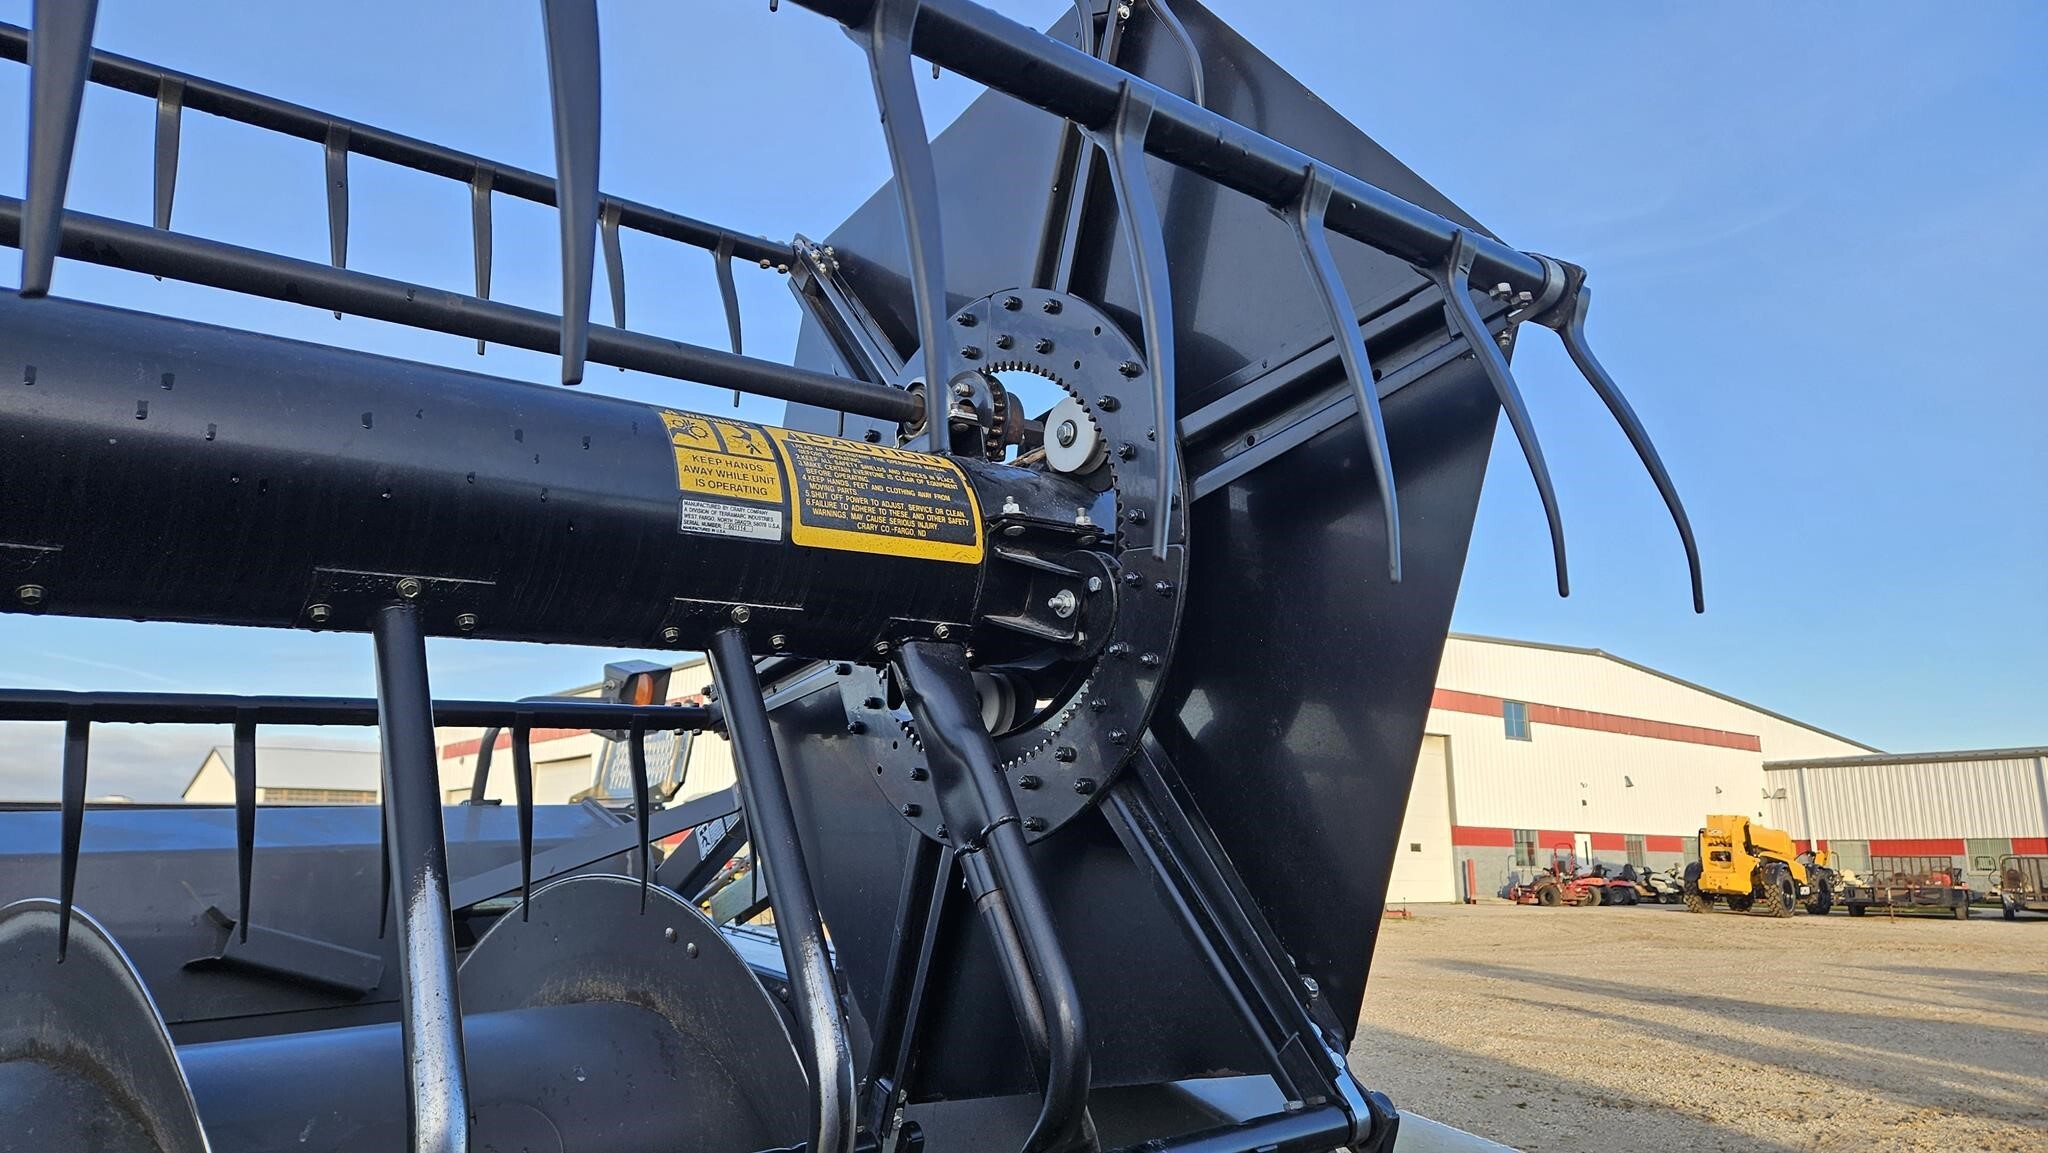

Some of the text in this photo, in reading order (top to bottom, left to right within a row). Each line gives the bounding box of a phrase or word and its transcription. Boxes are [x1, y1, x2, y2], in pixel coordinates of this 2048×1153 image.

[797, 449, 822, 457] BEFORE
[807, 435, 942, 464] CAUTION
[692, 455, 763, 472] KEEP HANDS
[683, 465, 775, 485] AWAY WHILE UNIT
[805, 468, 832, 477] BEFORE
[824, 463, 851, 473] CERTAIN
[853, 468, 885, 478] EVERYONE
[895, 475, 915, 483] CLEAR
[902, 470, 927, 479] DEVICES
[695, 479, 767, 496] IS OPERATING
[809, 483, 835, 492] MOVING
[886, 487, 915, 496] CLOTHING
[934, 493, 951, 501] FROM
[684, 501, 721, 509] MANUFACTURED
[846, 495, 869, 505] POWER
[908, 504, 933, 513] SERVICE
[812, 508, 849, 520] WARNINGS,
[865, 515, 886, 524] CAUSE
[889, 518, 915, 527] SERIOUS
[917, 521, 939, 530] INJURY.
[851, 505, 876, 514] ADHERE
[879, 508, 887, 516] TO
[926, 514, 946, 523] OTHER
[948, 518, 969, 526] SAFETY
[857, 522, 878, 531] CRARY
